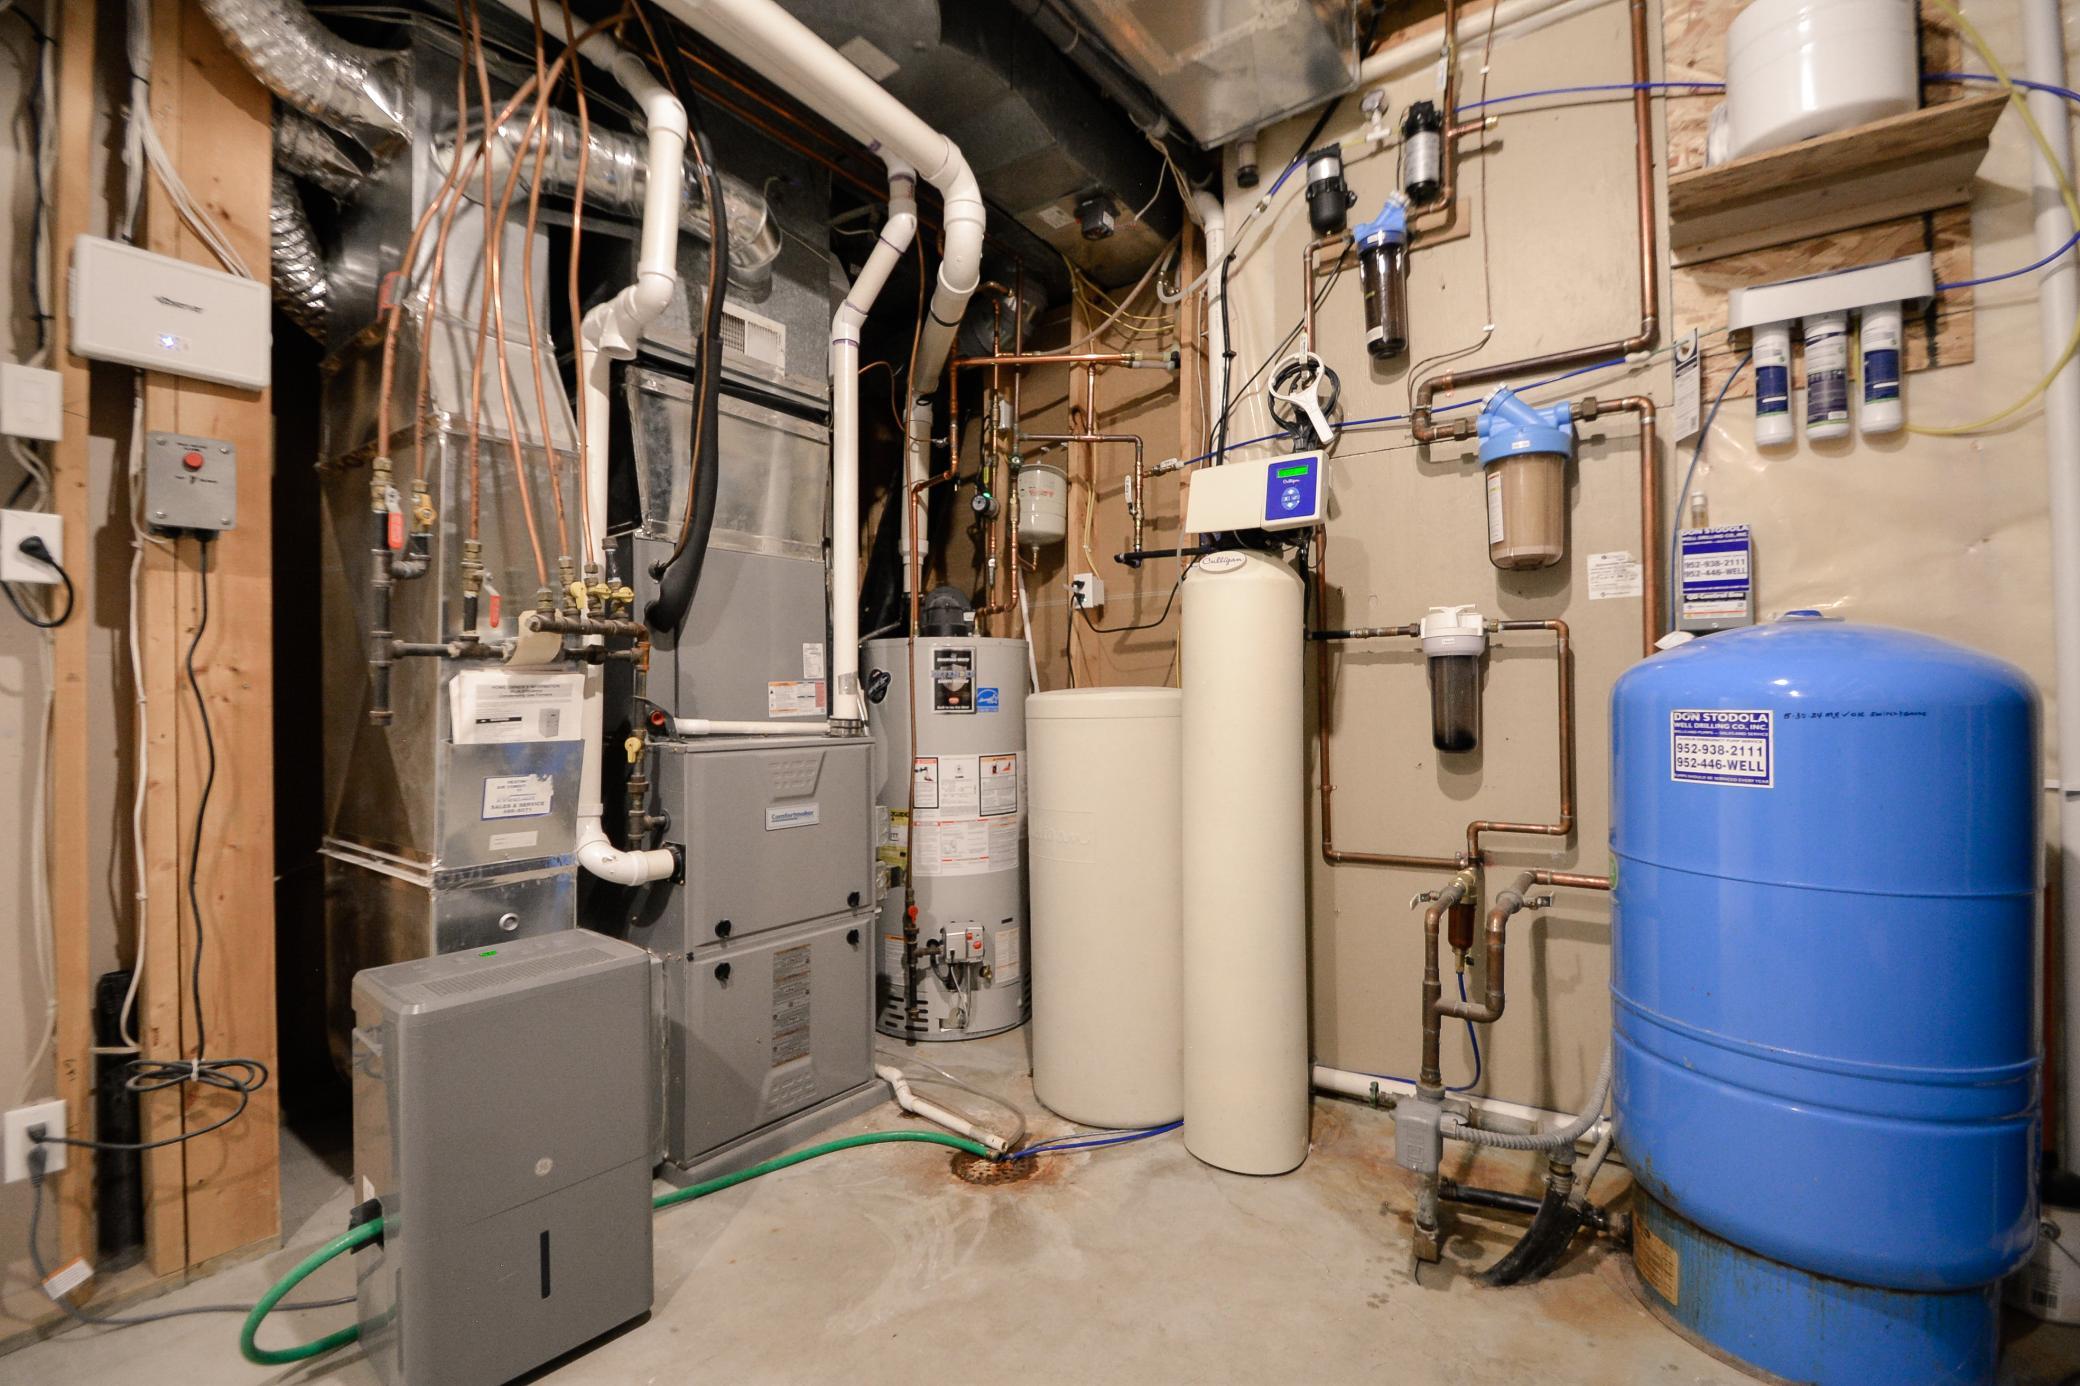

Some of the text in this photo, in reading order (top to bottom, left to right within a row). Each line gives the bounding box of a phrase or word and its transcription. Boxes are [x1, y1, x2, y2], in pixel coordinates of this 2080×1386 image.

[1202, 554, 1242, 566] Culligan
[1674, 713, 1768, 722] DON STODOLA
[1677, 743, 1762, 757] 952-938-2111
[1677, 757, 1764, 772] 952-446-WELL
